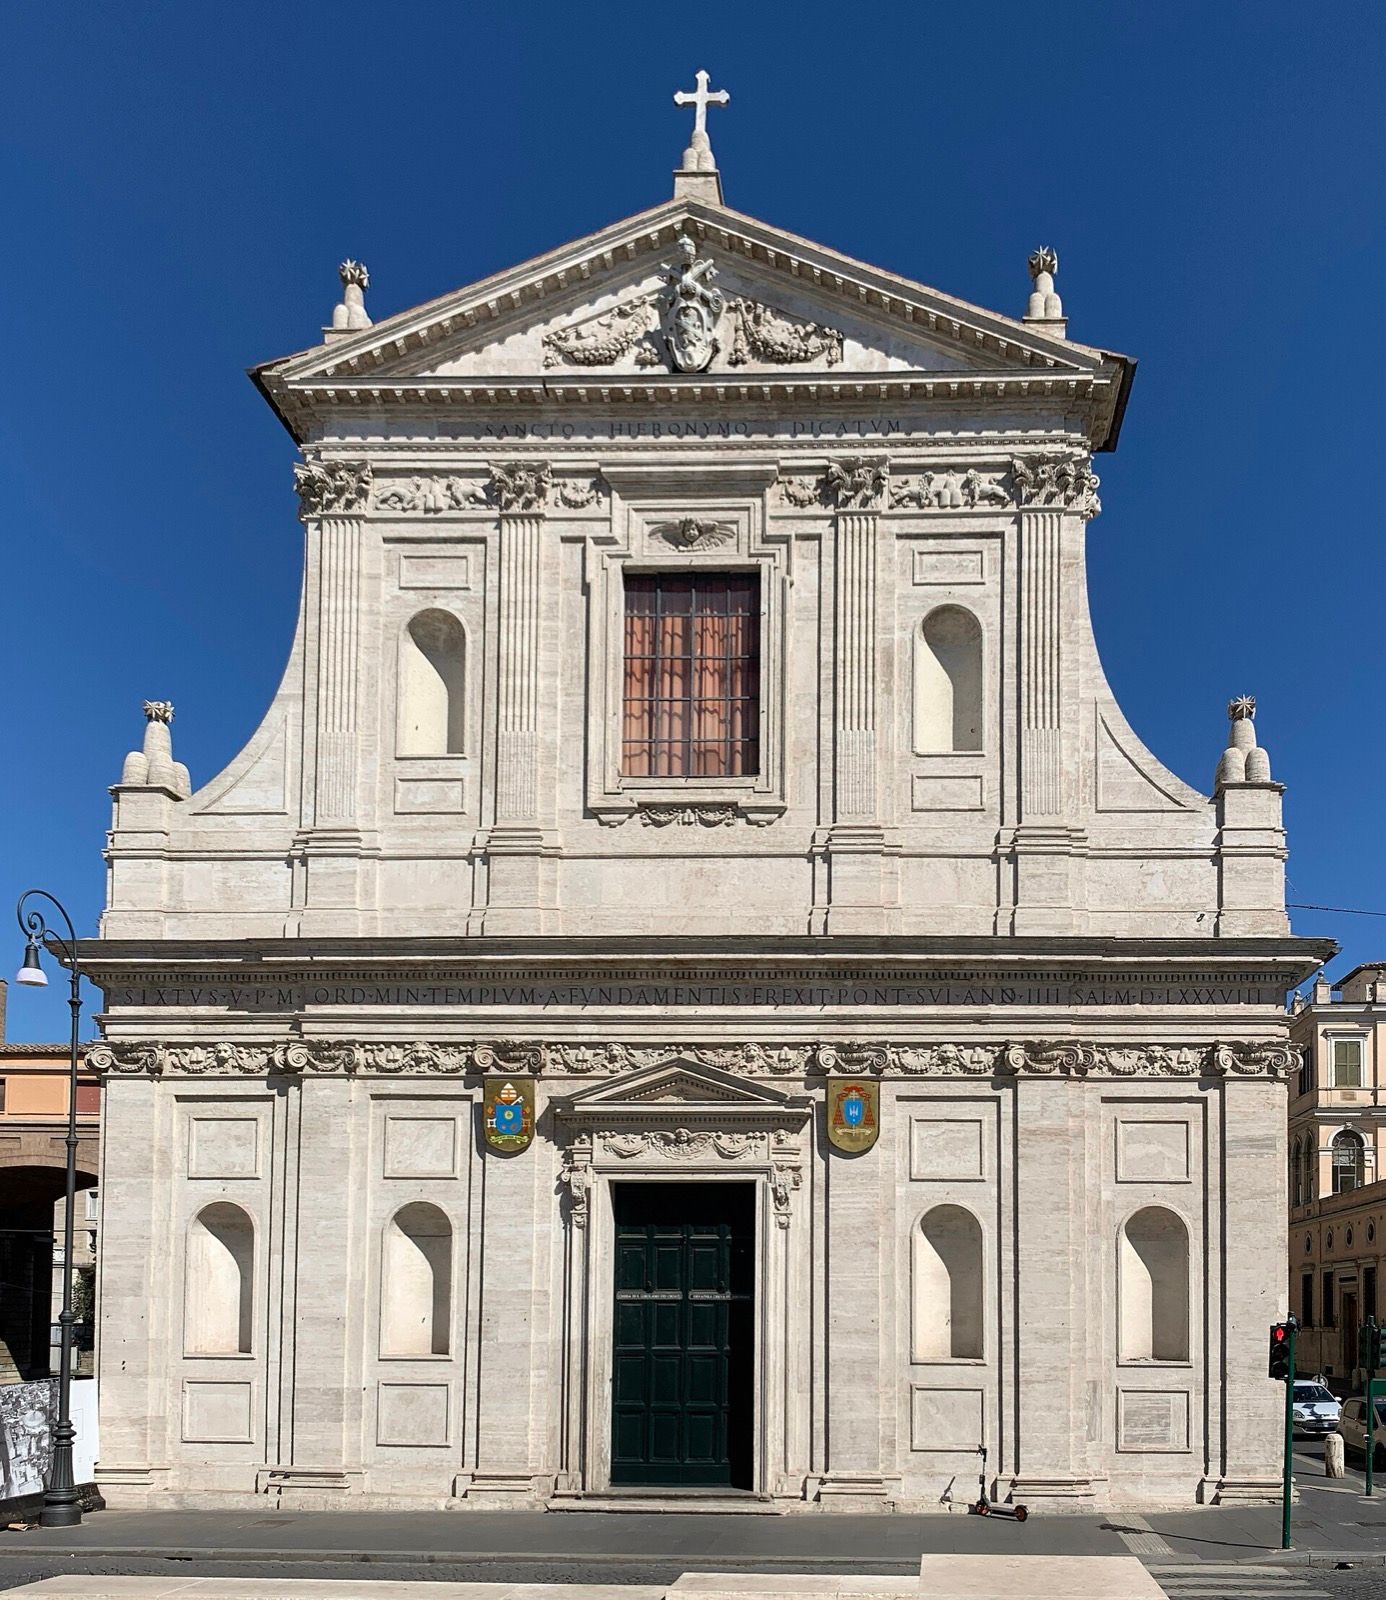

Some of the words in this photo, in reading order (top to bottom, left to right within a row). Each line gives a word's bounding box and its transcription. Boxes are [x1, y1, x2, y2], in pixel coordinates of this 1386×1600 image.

[484, 423, 575, 437] SANCTO
[610, 422, 748, 436] HIERONYMO
[792, 420, 900, 435] DICATVM
[123, 988, 219, 1005] SIXTVS
[314, 987, 366, 1004] ORD
[370, 987, 420, 1004] MIN
[428, 987, 536, 1004] TEMPLVM
[568, 987, 742, 1005] FVNDAMENTIS
[752, 987, 830, 1005] EREXIT
[838, 988, 906, 1005] PONT
[915, 988, 951, 1005] SVI
